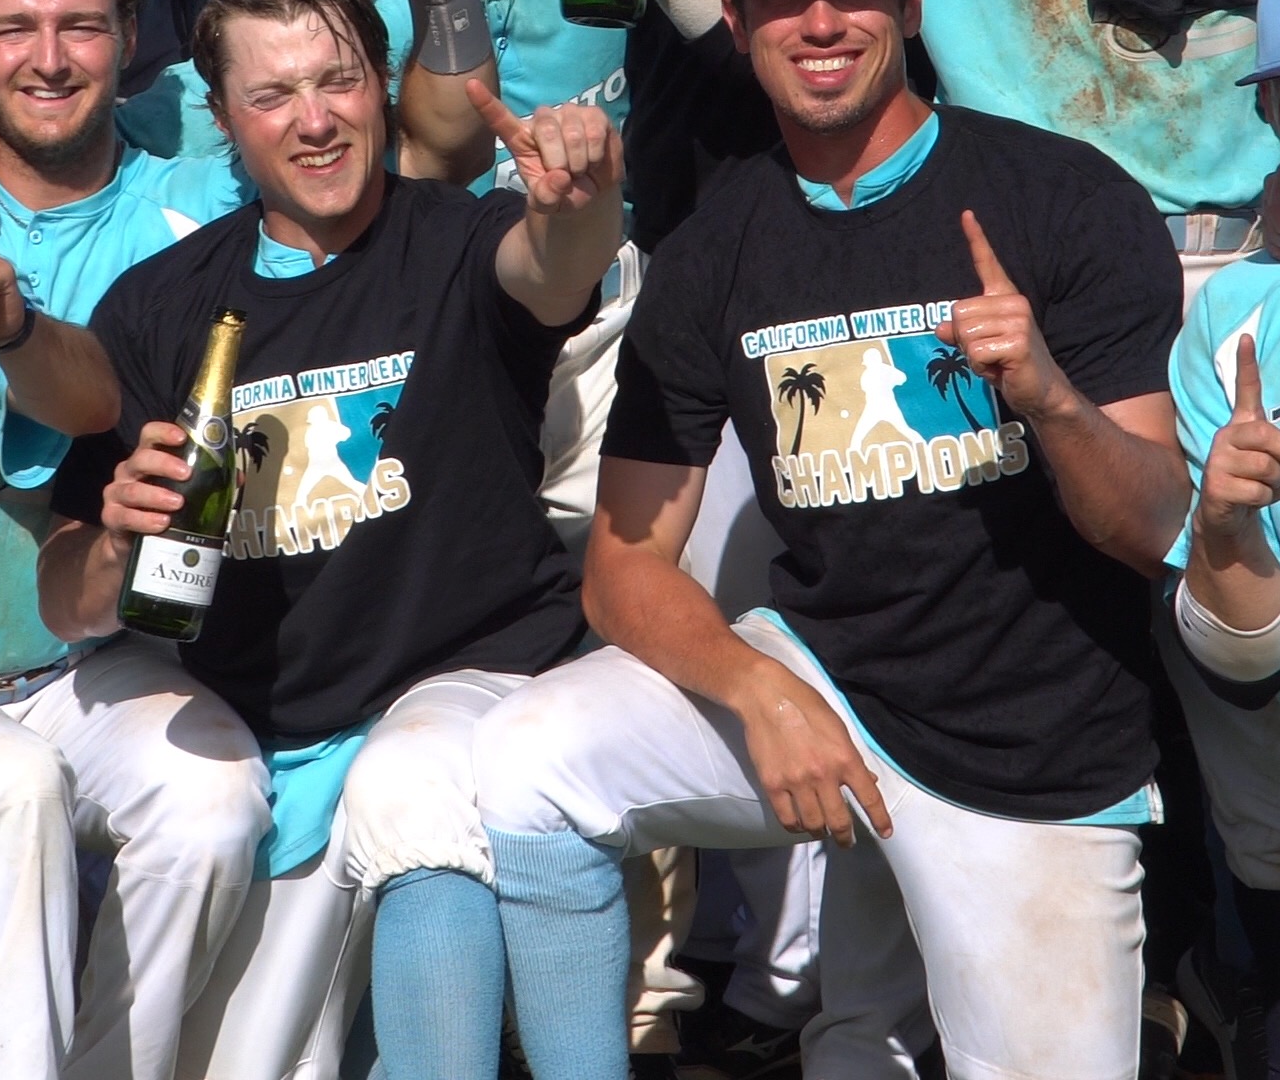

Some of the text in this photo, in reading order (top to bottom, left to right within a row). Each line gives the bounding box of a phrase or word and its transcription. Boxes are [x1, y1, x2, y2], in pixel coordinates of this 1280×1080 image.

[742, 317, 848, 359] CALIFORNIA
[851, 302, 925, 340] WINTER
[297, 361, 368, 397] WINTER
[771, 420, 1030, 510] CHAMPIONS
[150, 562, 214, 588] ANDRÉ
